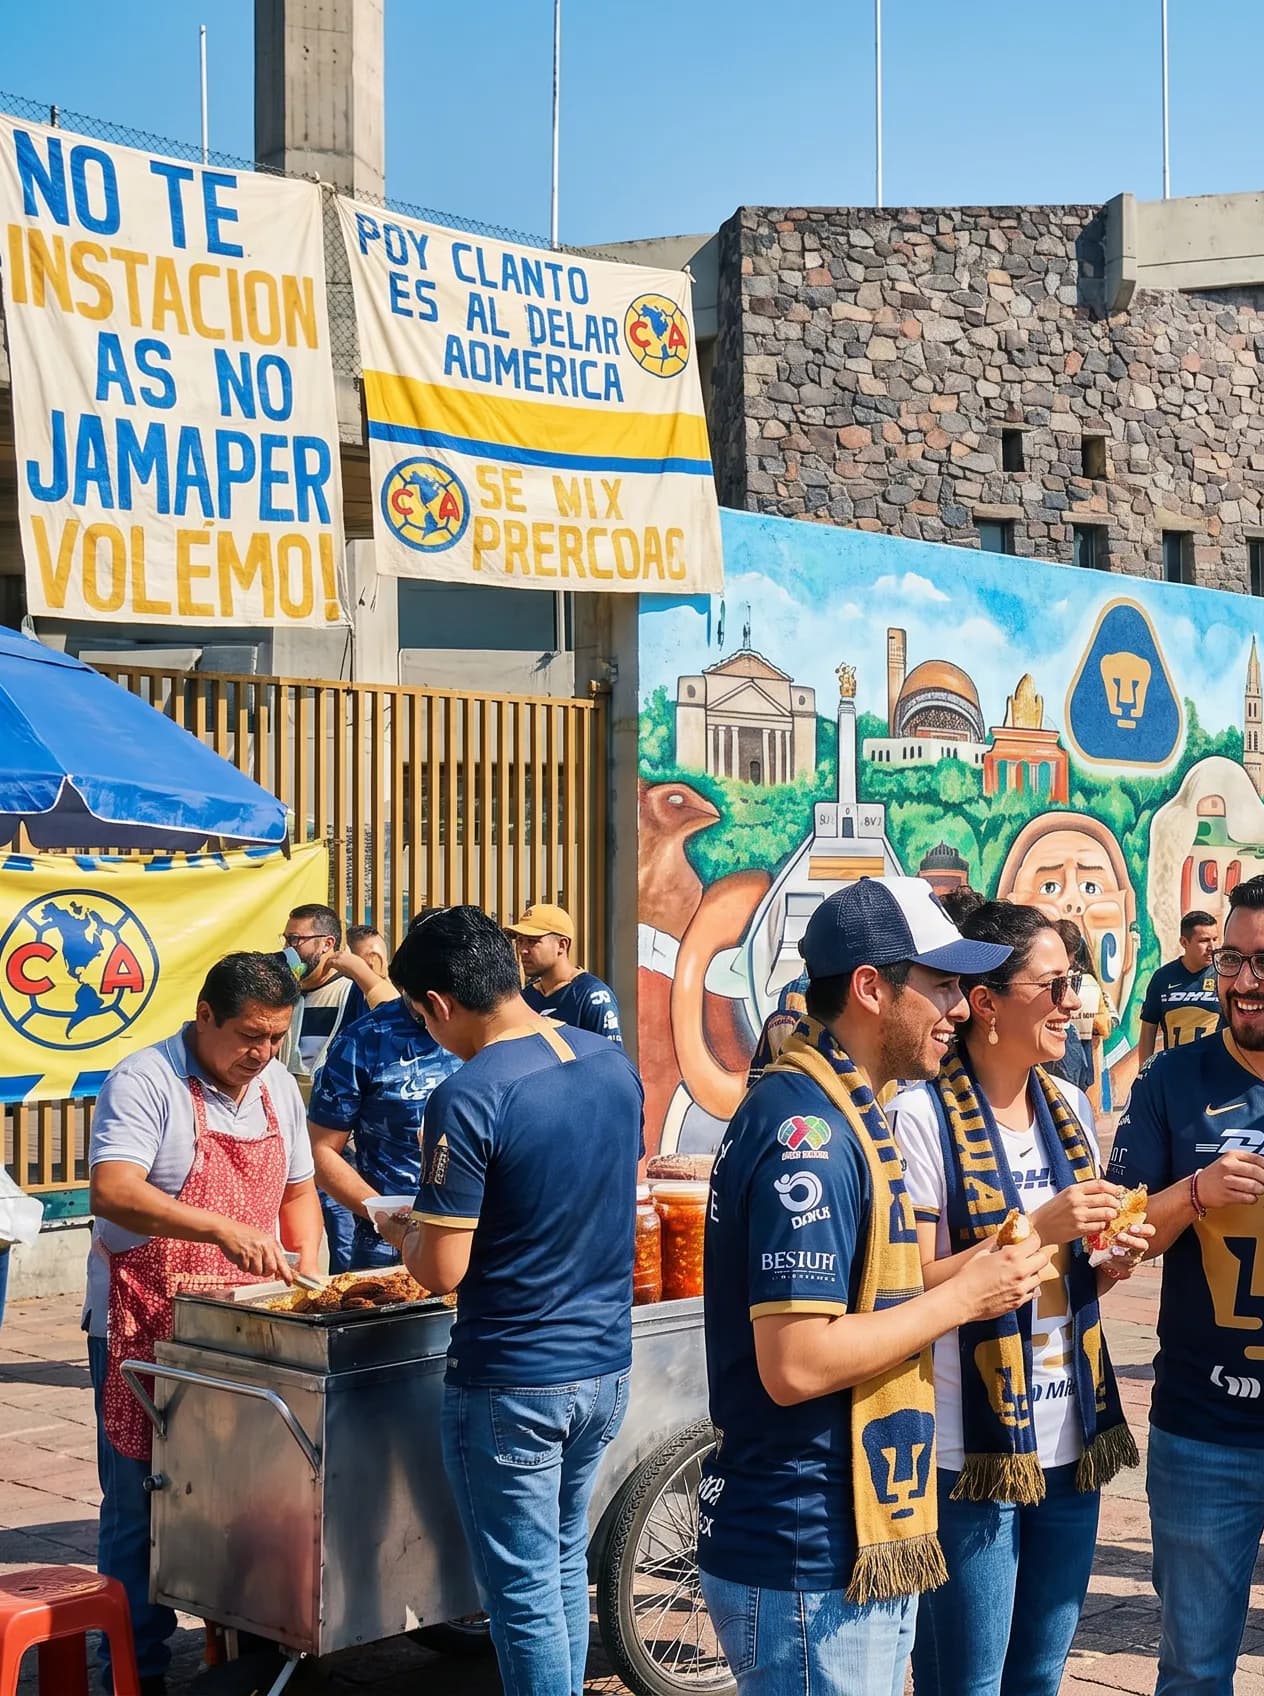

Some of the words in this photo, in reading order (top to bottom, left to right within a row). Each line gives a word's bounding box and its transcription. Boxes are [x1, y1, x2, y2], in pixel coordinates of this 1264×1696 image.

[13, 129, 121, 236] NO
[150, 161, 243, 257] TE
[7, 223, 318, 350] INSTACION
[355, 212, 429, 271] POY
[451, 241, 589, 305] CLANTO
[389, 270, 439, 322] ES
[466, 292, 510, 339] AL
[95, 331, 176, 409] AS
[215, 348, 292, 421] NO
[27, 409, 332, 525] JAMAPER
[475, 464, 527, 513] SE
[552, 474, 624, 521] MIX
